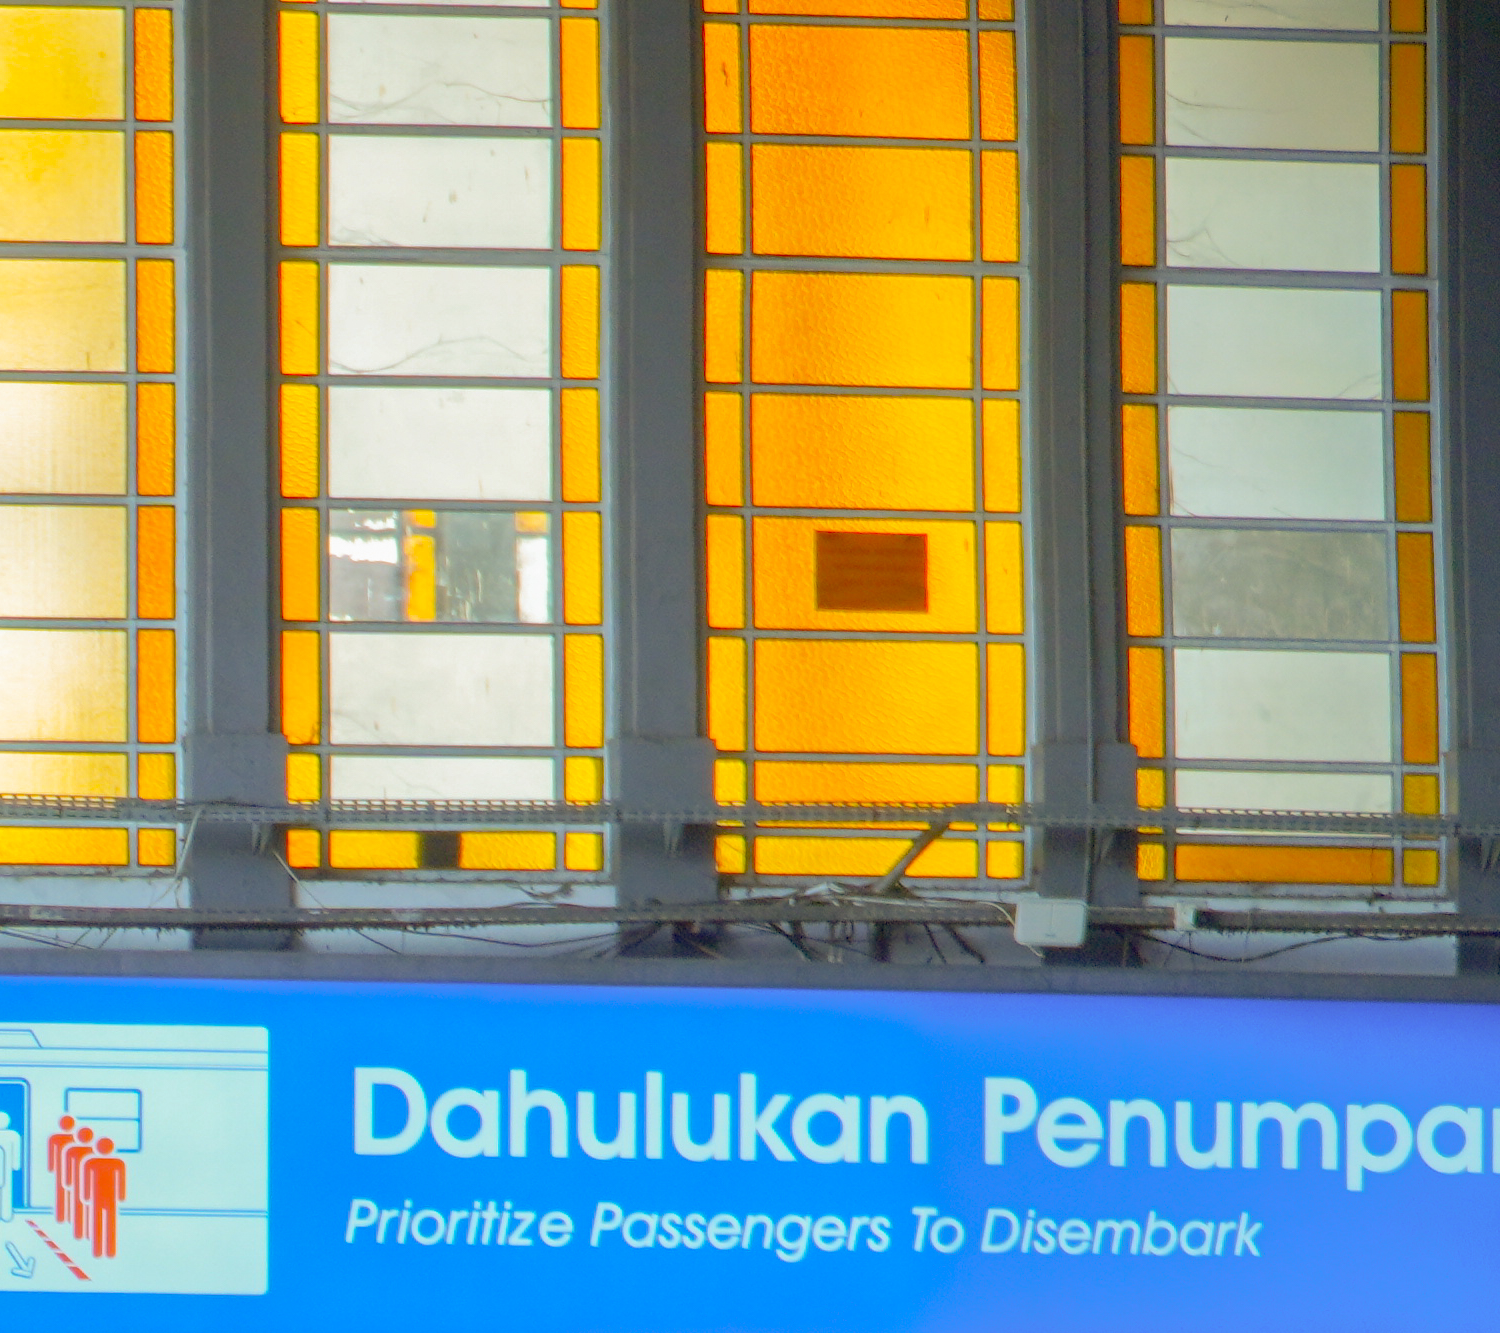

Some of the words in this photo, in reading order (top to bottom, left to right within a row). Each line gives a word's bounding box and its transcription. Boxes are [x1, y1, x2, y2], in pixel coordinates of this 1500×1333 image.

[353, 1066, 929, 1165] Dahulukan
[345, 1199, 574, 1247] Prioritize
[591, 1202, 891, 1263] Passengers
[911, 1206, 964, 1254] To
[981, 1208, 1262, 1257] Disembark
